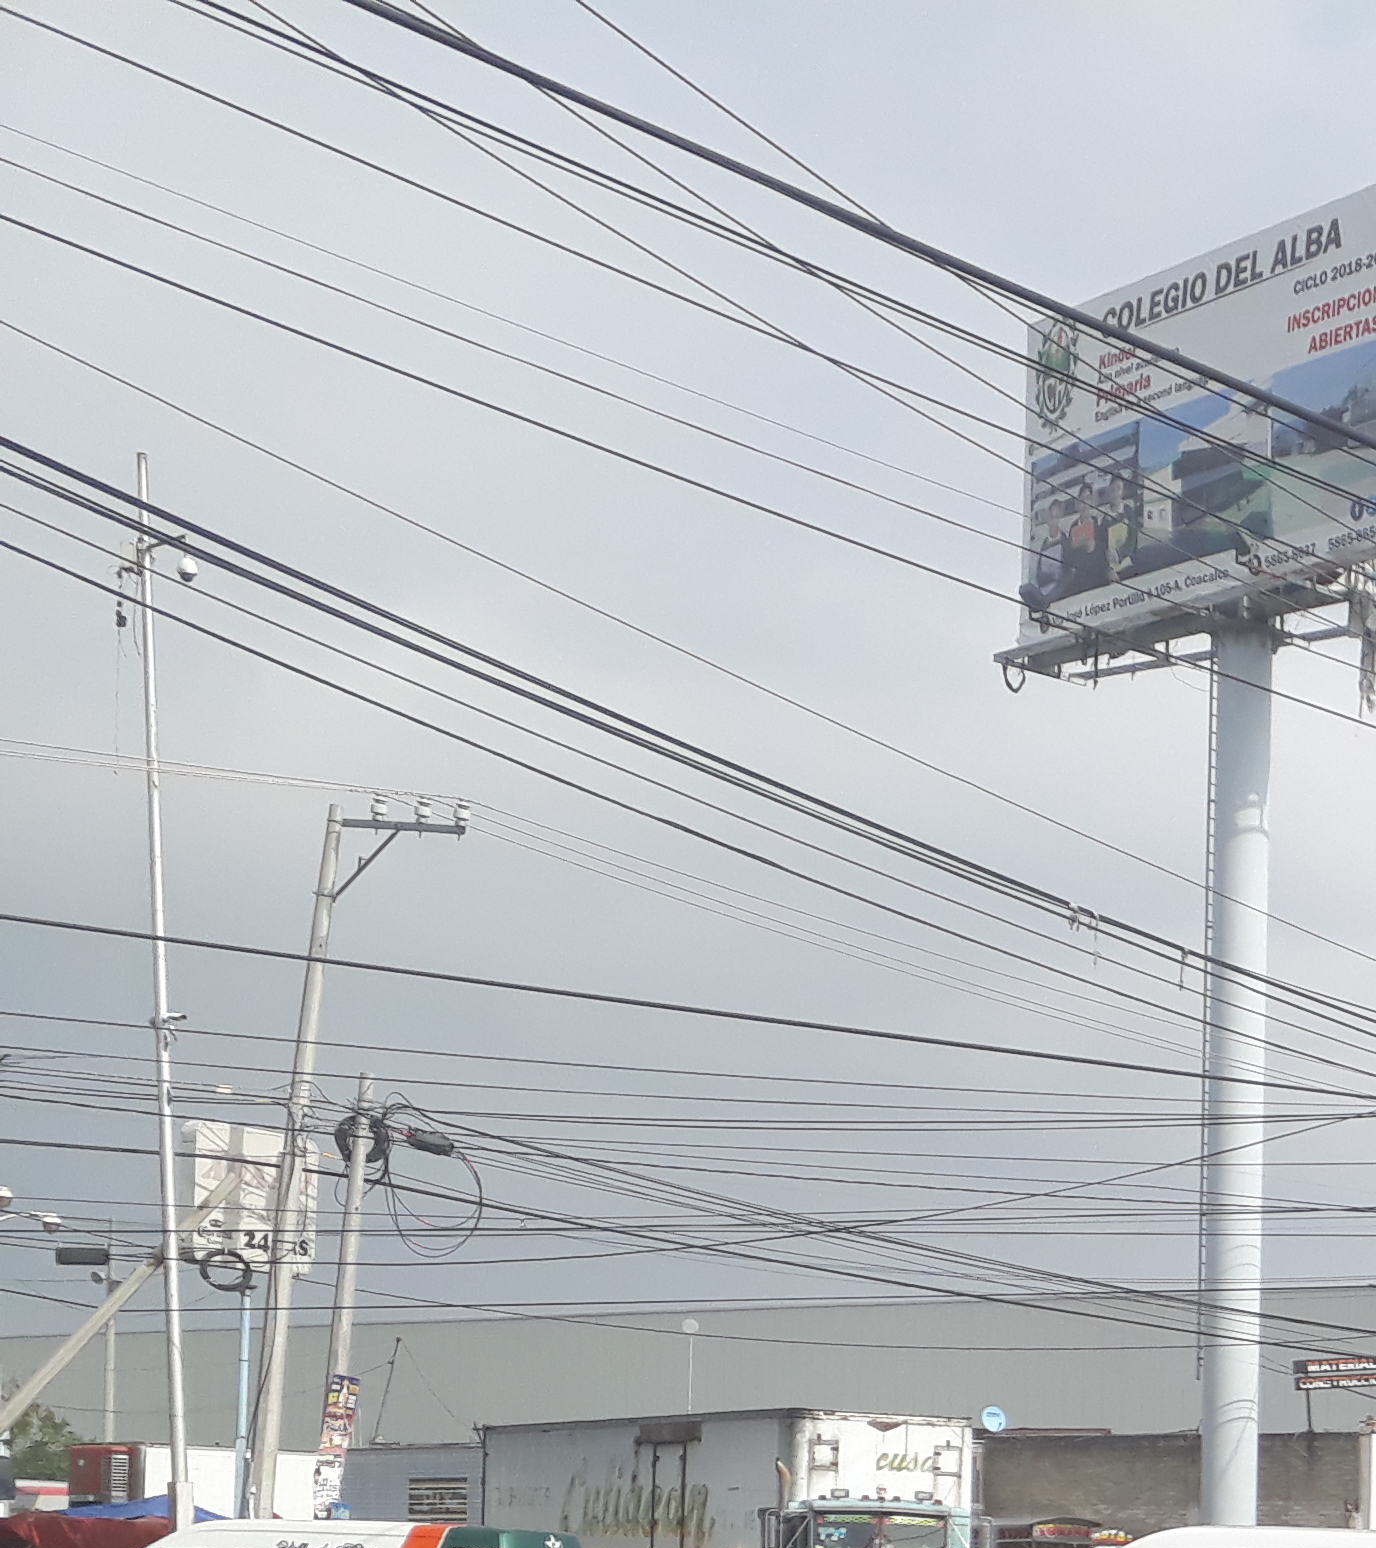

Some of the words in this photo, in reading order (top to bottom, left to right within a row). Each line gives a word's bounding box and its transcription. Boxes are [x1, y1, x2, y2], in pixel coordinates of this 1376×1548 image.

[1101, 271, 1207, 338] COLEGIO
[1215, 250, 1264, 295] DEL
[1271, 218, 1343, 274] ALBA
[1294, 273, 1328, 295] CICLO
